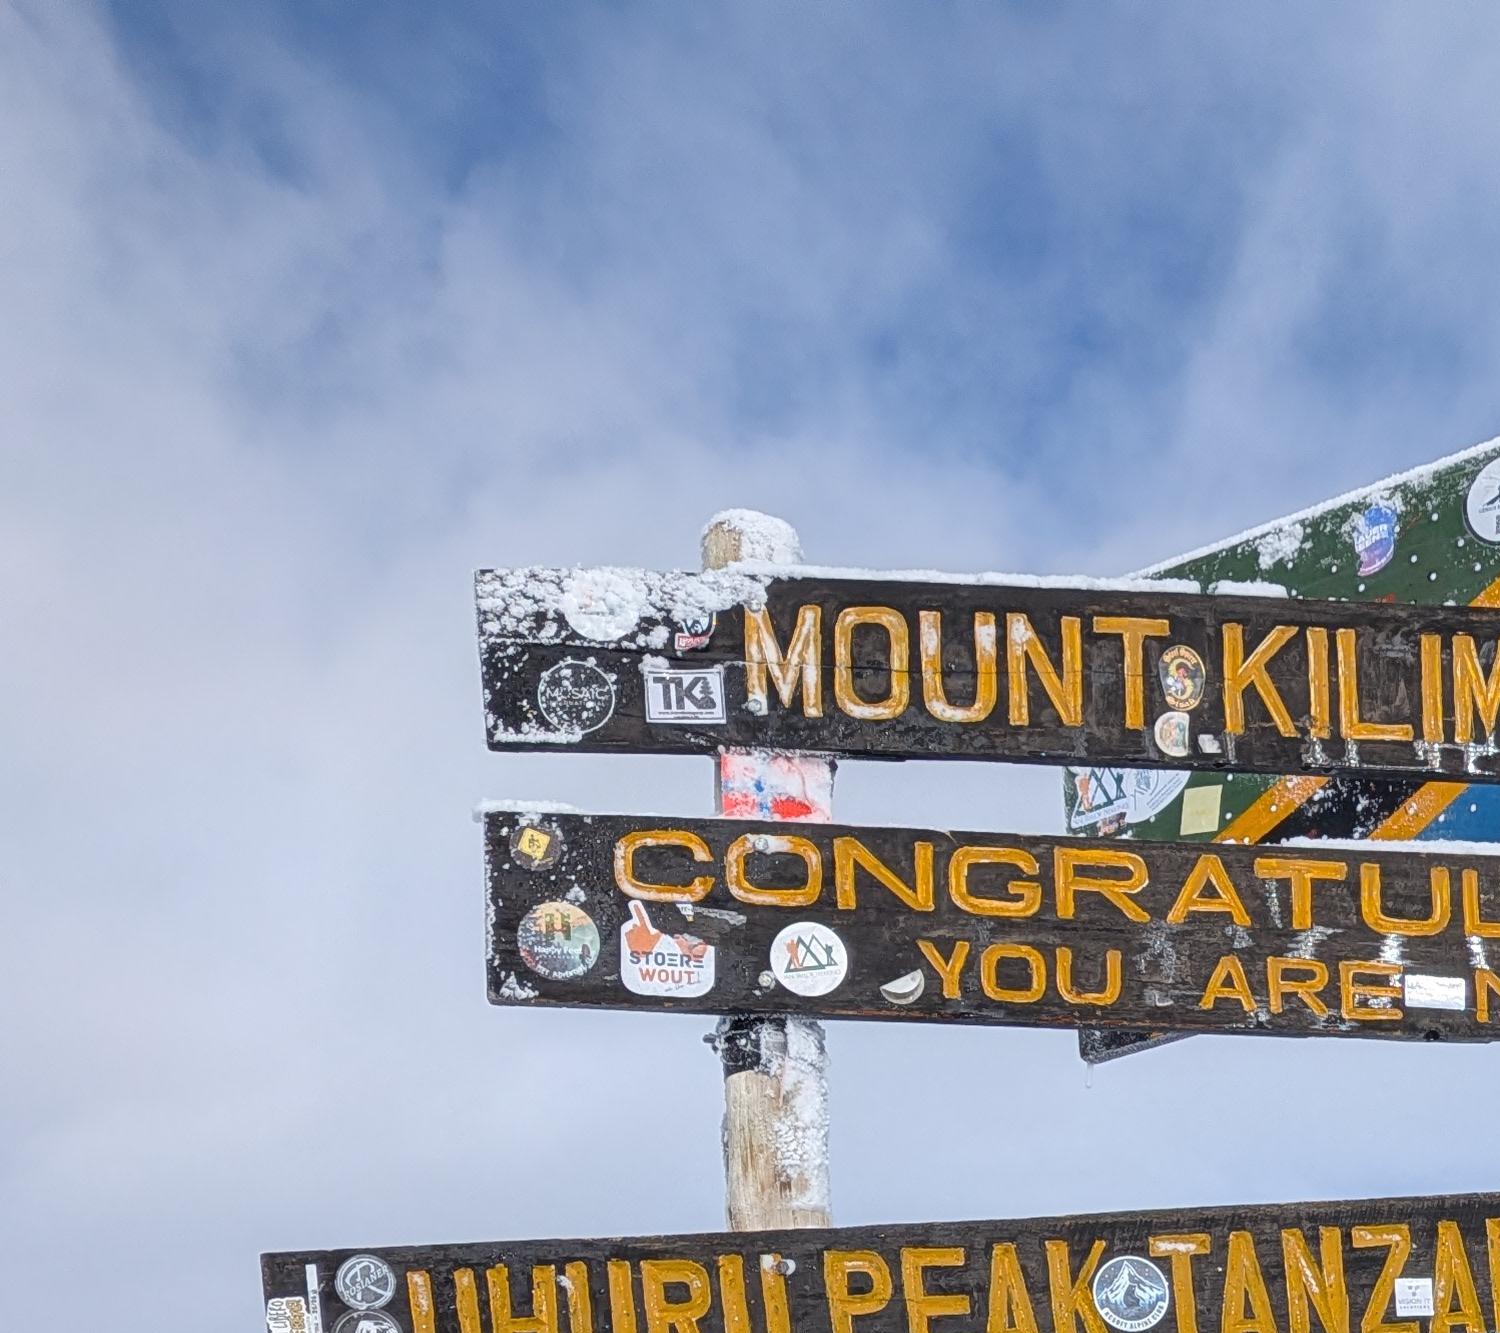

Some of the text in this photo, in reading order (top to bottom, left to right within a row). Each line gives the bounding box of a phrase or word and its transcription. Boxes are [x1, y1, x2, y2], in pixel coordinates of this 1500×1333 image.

[744, 602, 1170, 730] MOUNT
[629, 950, 705, 969] STOERE
[918, 938, 1121, 1006] YOU
[1200, 954, 1404, 1021] ARE
